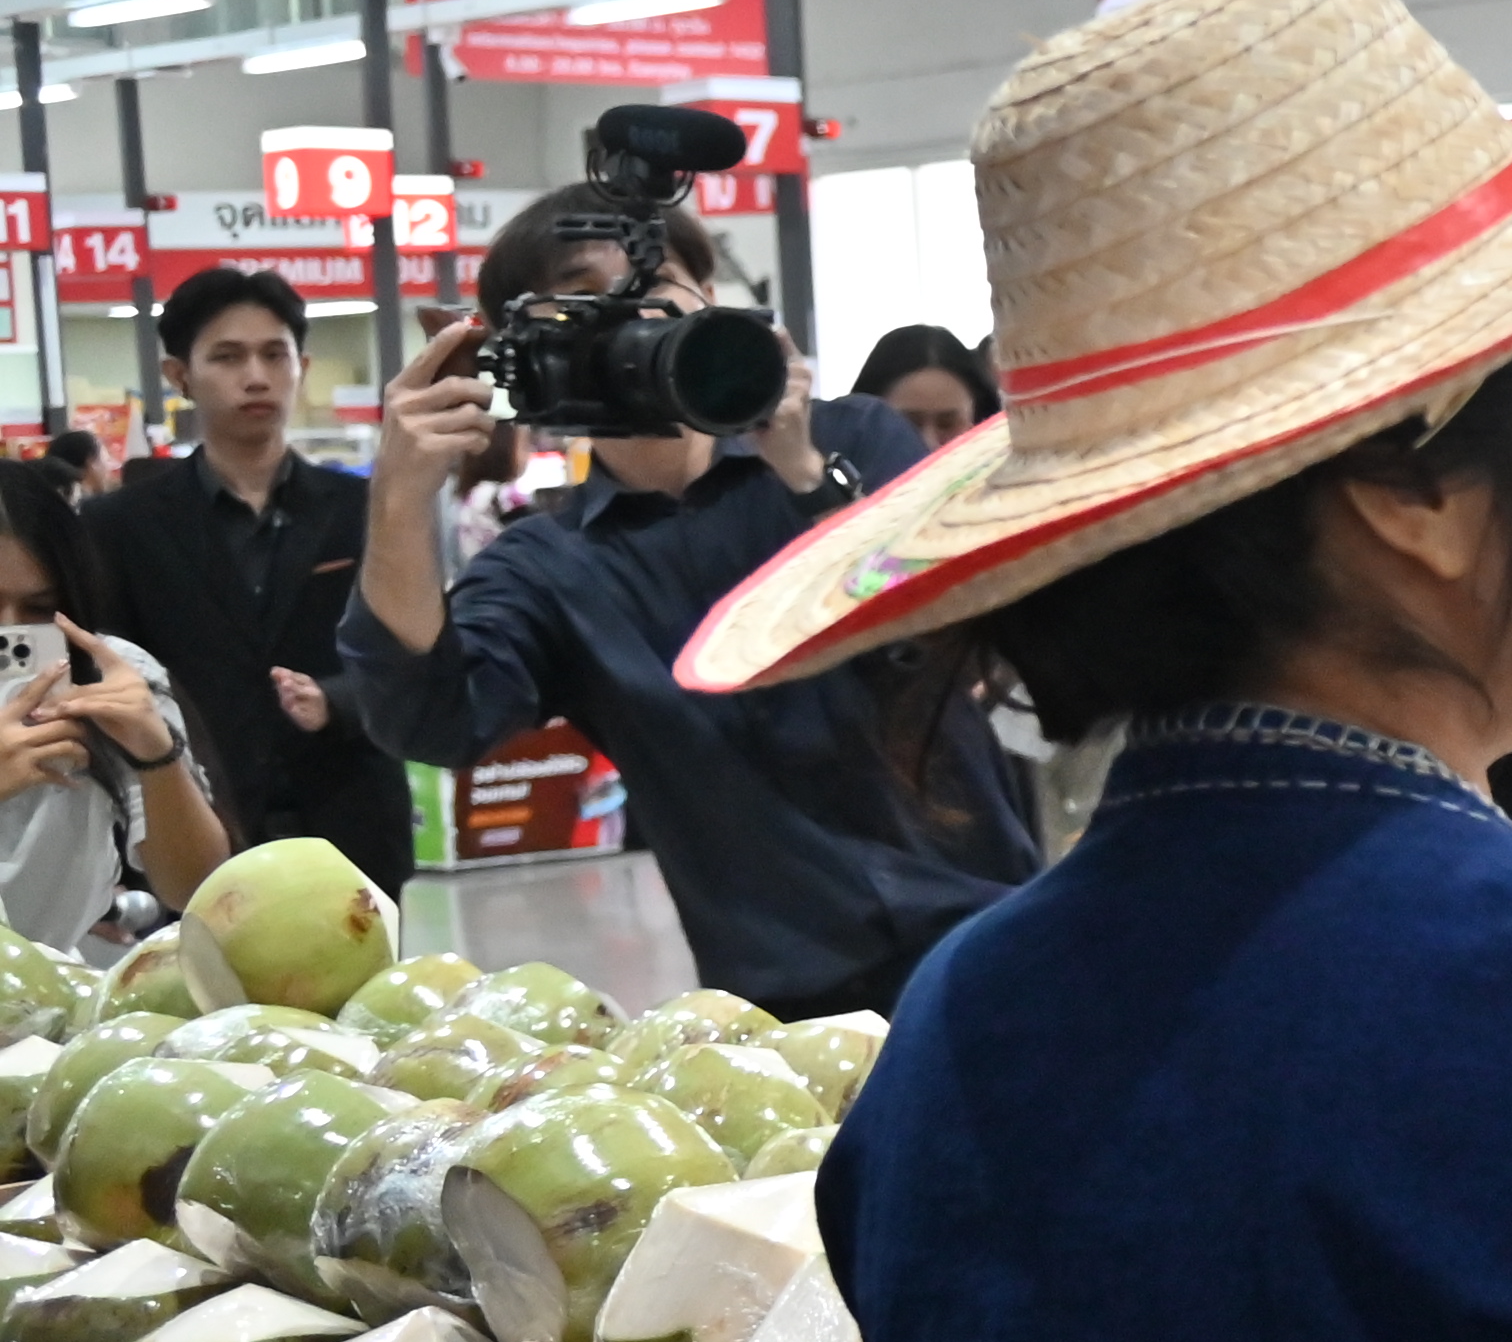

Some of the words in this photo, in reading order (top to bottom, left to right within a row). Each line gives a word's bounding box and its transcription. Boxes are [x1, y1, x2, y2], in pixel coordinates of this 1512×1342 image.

[734, 109, 778, 167] 7
[328, 155, 373, 209] 9
[392, 198, 450, 247] 12
[84, 230, 141, 273] 14
